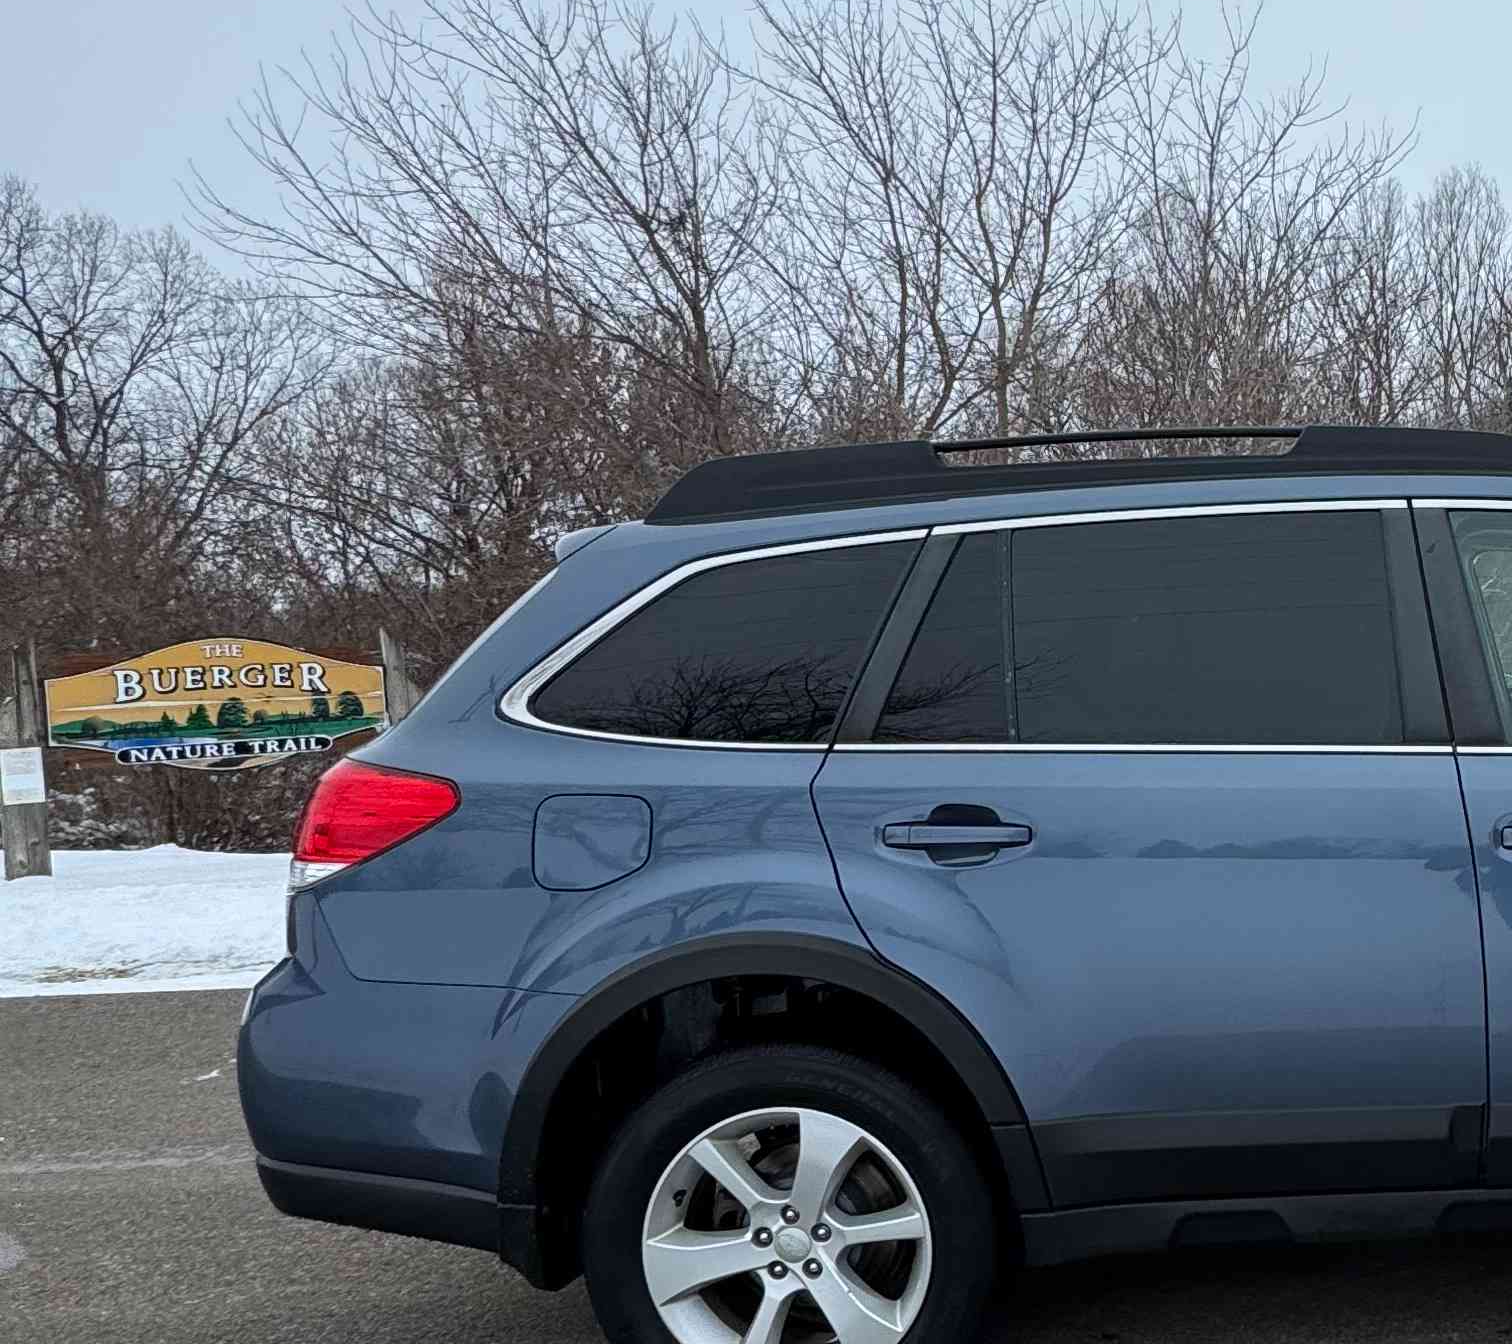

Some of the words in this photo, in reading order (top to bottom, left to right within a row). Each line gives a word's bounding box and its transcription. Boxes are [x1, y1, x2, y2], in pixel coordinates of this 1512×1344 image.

[202, 643, 243, 658] THE
[113, 662, 330, 704] BUERGER
[130, 742, 237, 763] NATURE
[249, 737, 322, 754] TRAIL
